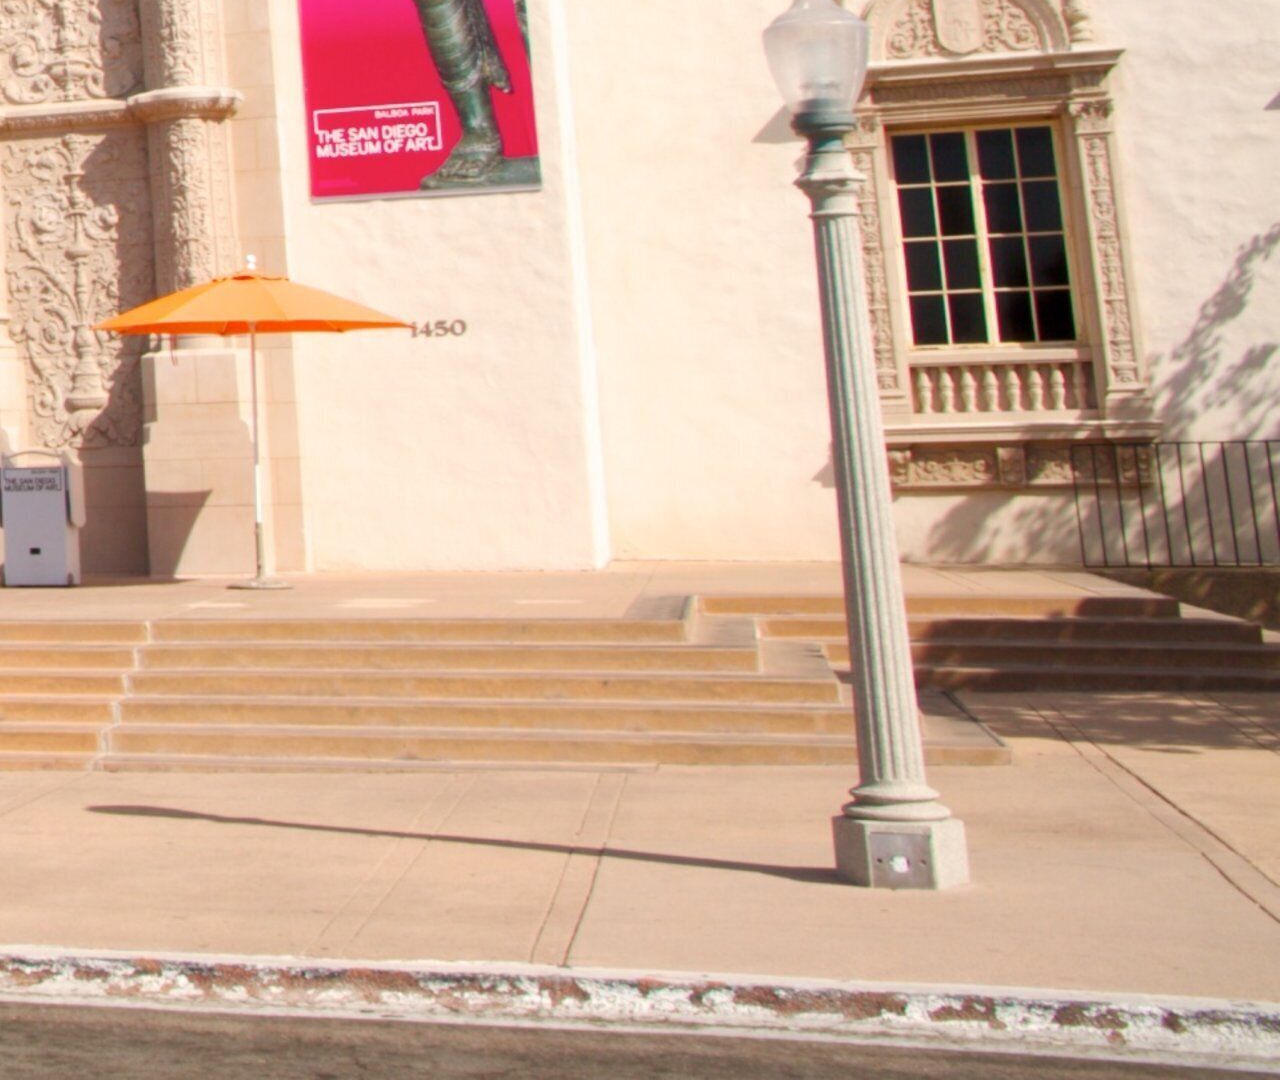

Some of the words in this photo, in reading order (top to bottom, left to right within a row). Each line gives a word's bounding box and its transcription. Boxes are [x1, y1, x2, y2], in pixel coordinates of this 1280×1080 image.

[374, 109, 409, 119] BALBOA
[411, 107, 435, 117] PARK
[317, 129, 346, 144] THE
[348, 127, 380, 142] SAN
[382, 123, 428, 140] DIEGO
[316, 140, 383, 158] MUSEUM
[384, 138, 402, 153] OF
[405, 136, 435, 151] ART
[411, 319, 467, 338] 1450
